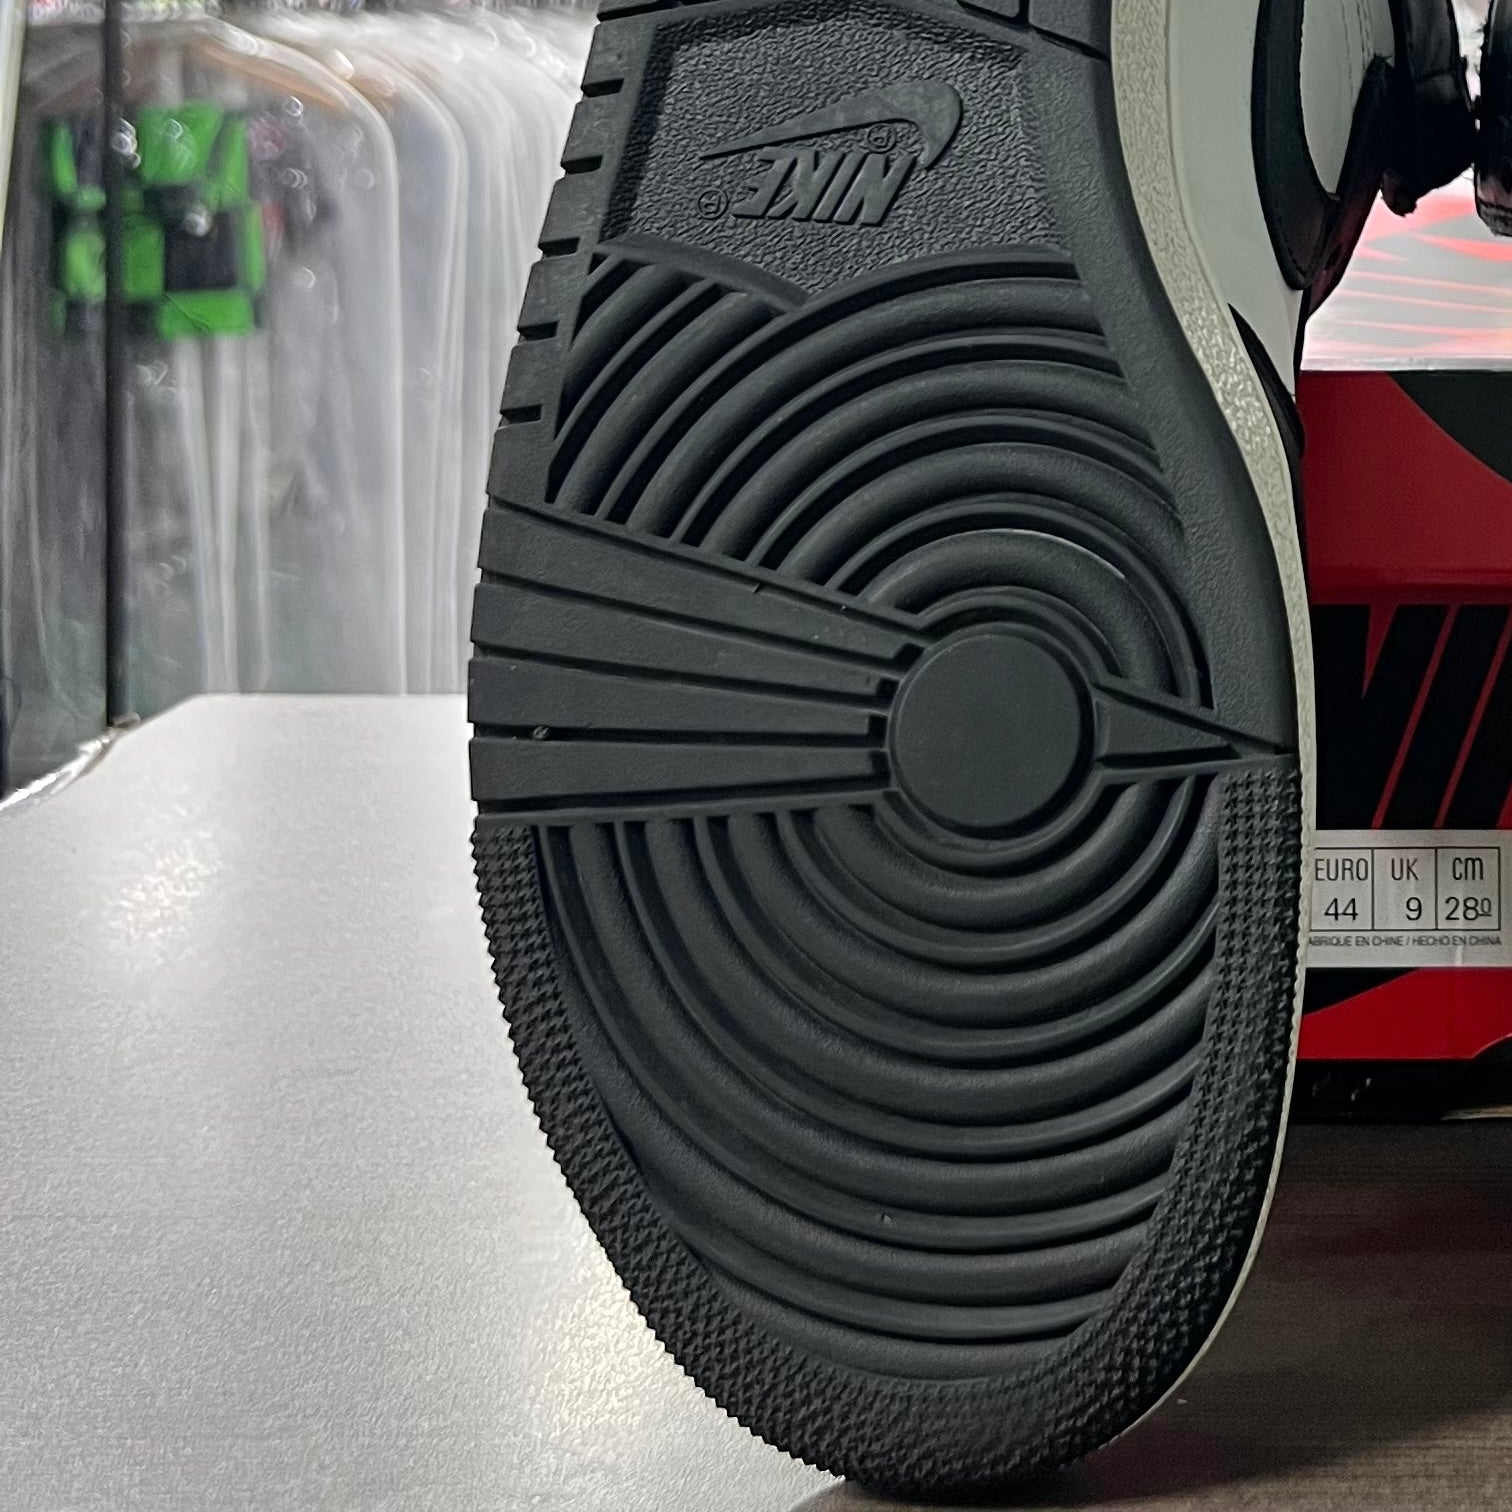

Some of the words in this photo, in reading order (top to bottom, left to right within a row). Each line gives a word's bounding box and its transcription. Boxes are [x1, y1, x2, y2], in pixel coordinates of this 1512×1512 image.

[732, 148, 918, 227] NIKE
[1314, 857, 1369, 882] EURO
[1390, 857, 1419, 881] UK
[1323, 897, 1359, 921] 44
[1405, 896, 1423, 921] 9
